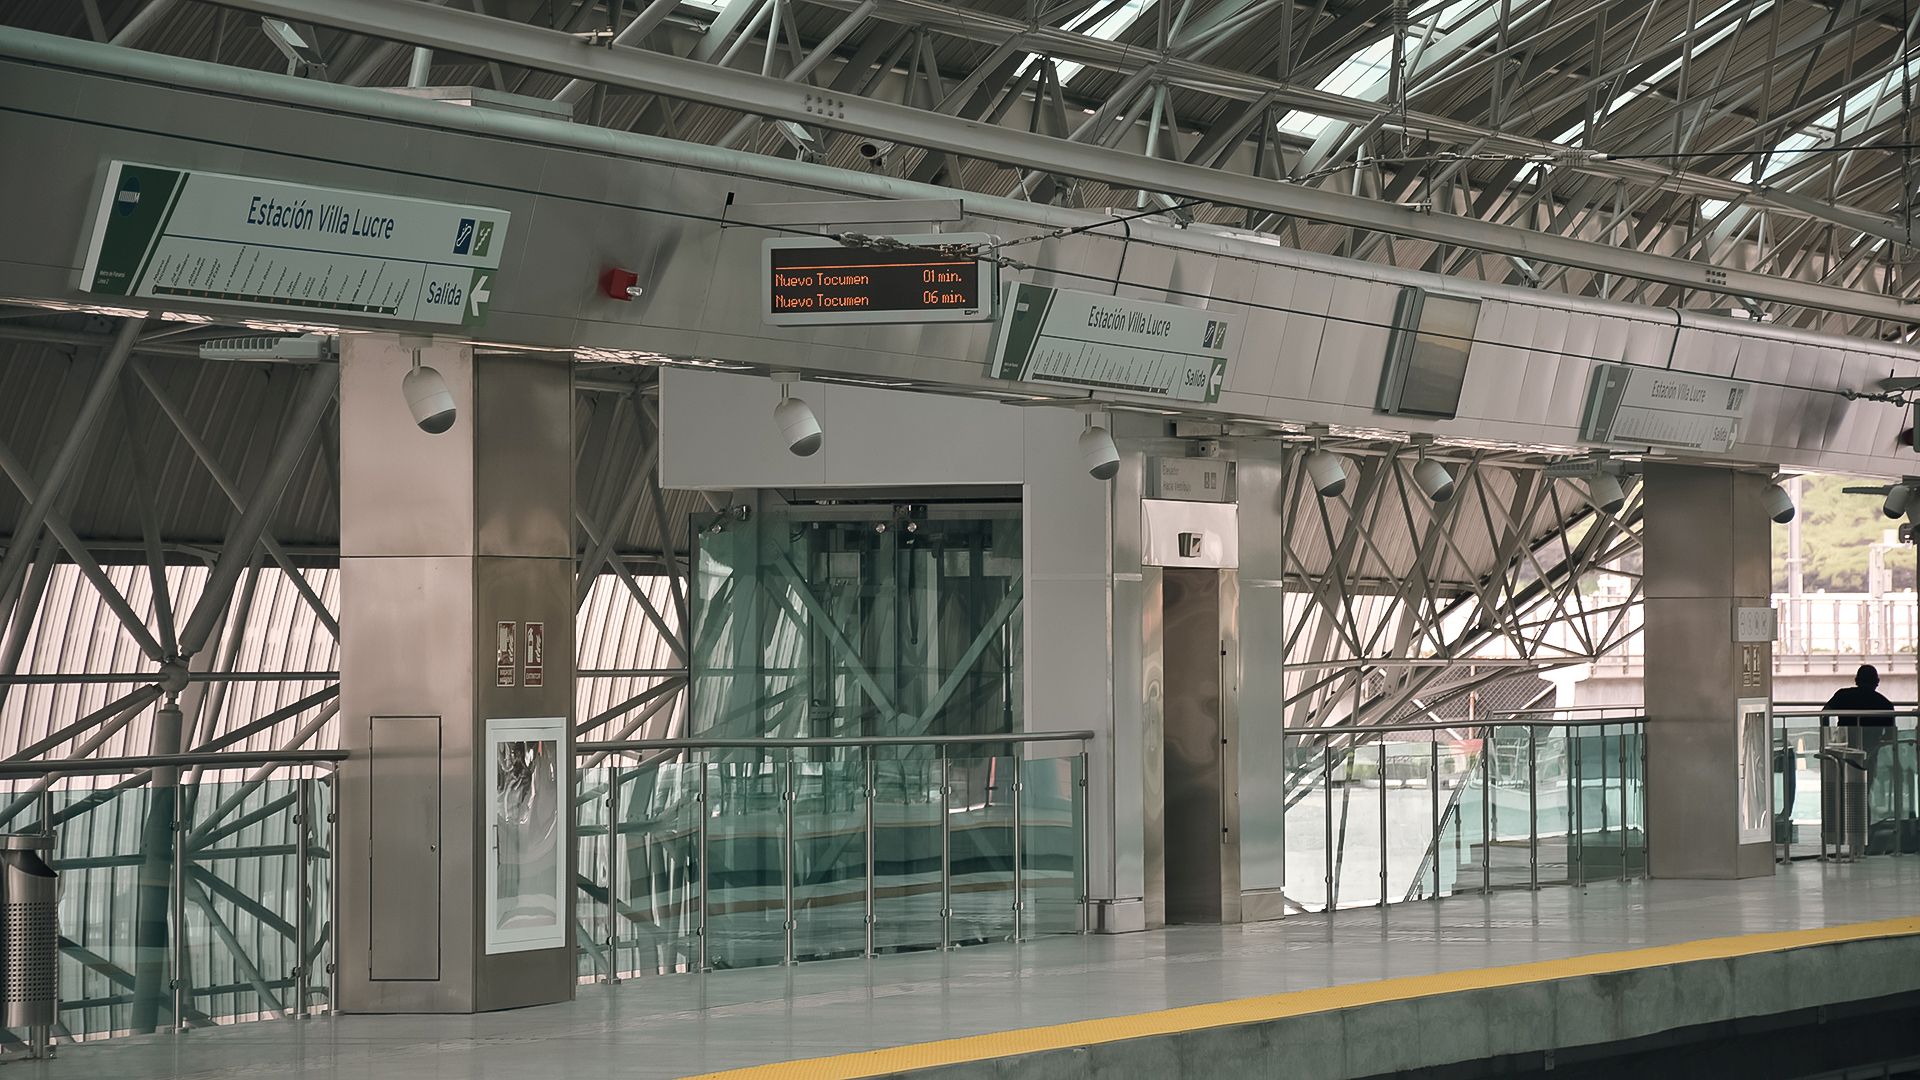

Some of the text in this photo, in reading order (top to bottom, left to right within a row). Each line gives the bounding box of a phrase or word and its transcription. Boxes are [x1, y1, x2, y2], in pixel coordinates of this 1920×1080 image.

[246, 195, 394, 239] Estación Villa Lucre
[775, 269, 962, 287] Nuevo Tocumen 01 min.
[426, 280, 462, 306] Salida
[775, 290, 966, 308] Nuevo Tocumen 06 min.
[1087, 305, 1171, 337] Estación Villa Lucre
[1185, 368, 1206, 388] Salida
